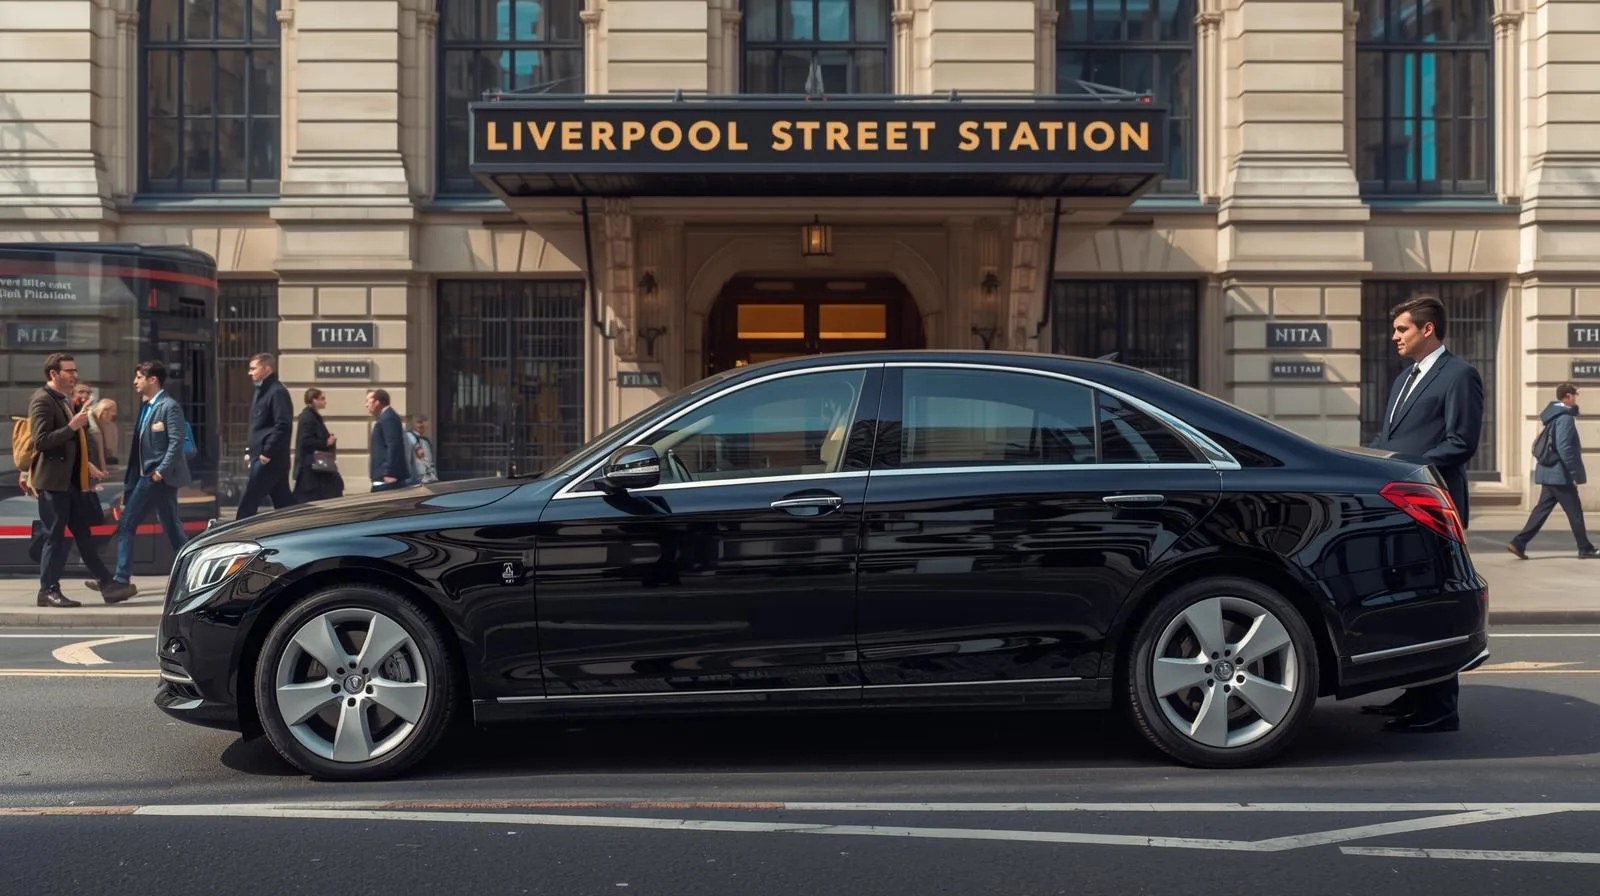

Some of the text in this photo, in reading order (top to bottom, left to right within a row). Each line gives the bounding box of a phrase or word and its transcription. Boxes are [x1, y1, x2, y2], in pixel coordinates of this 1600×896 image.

[487, 120, 1149, 152] LIVERPOOL STREET STATION
